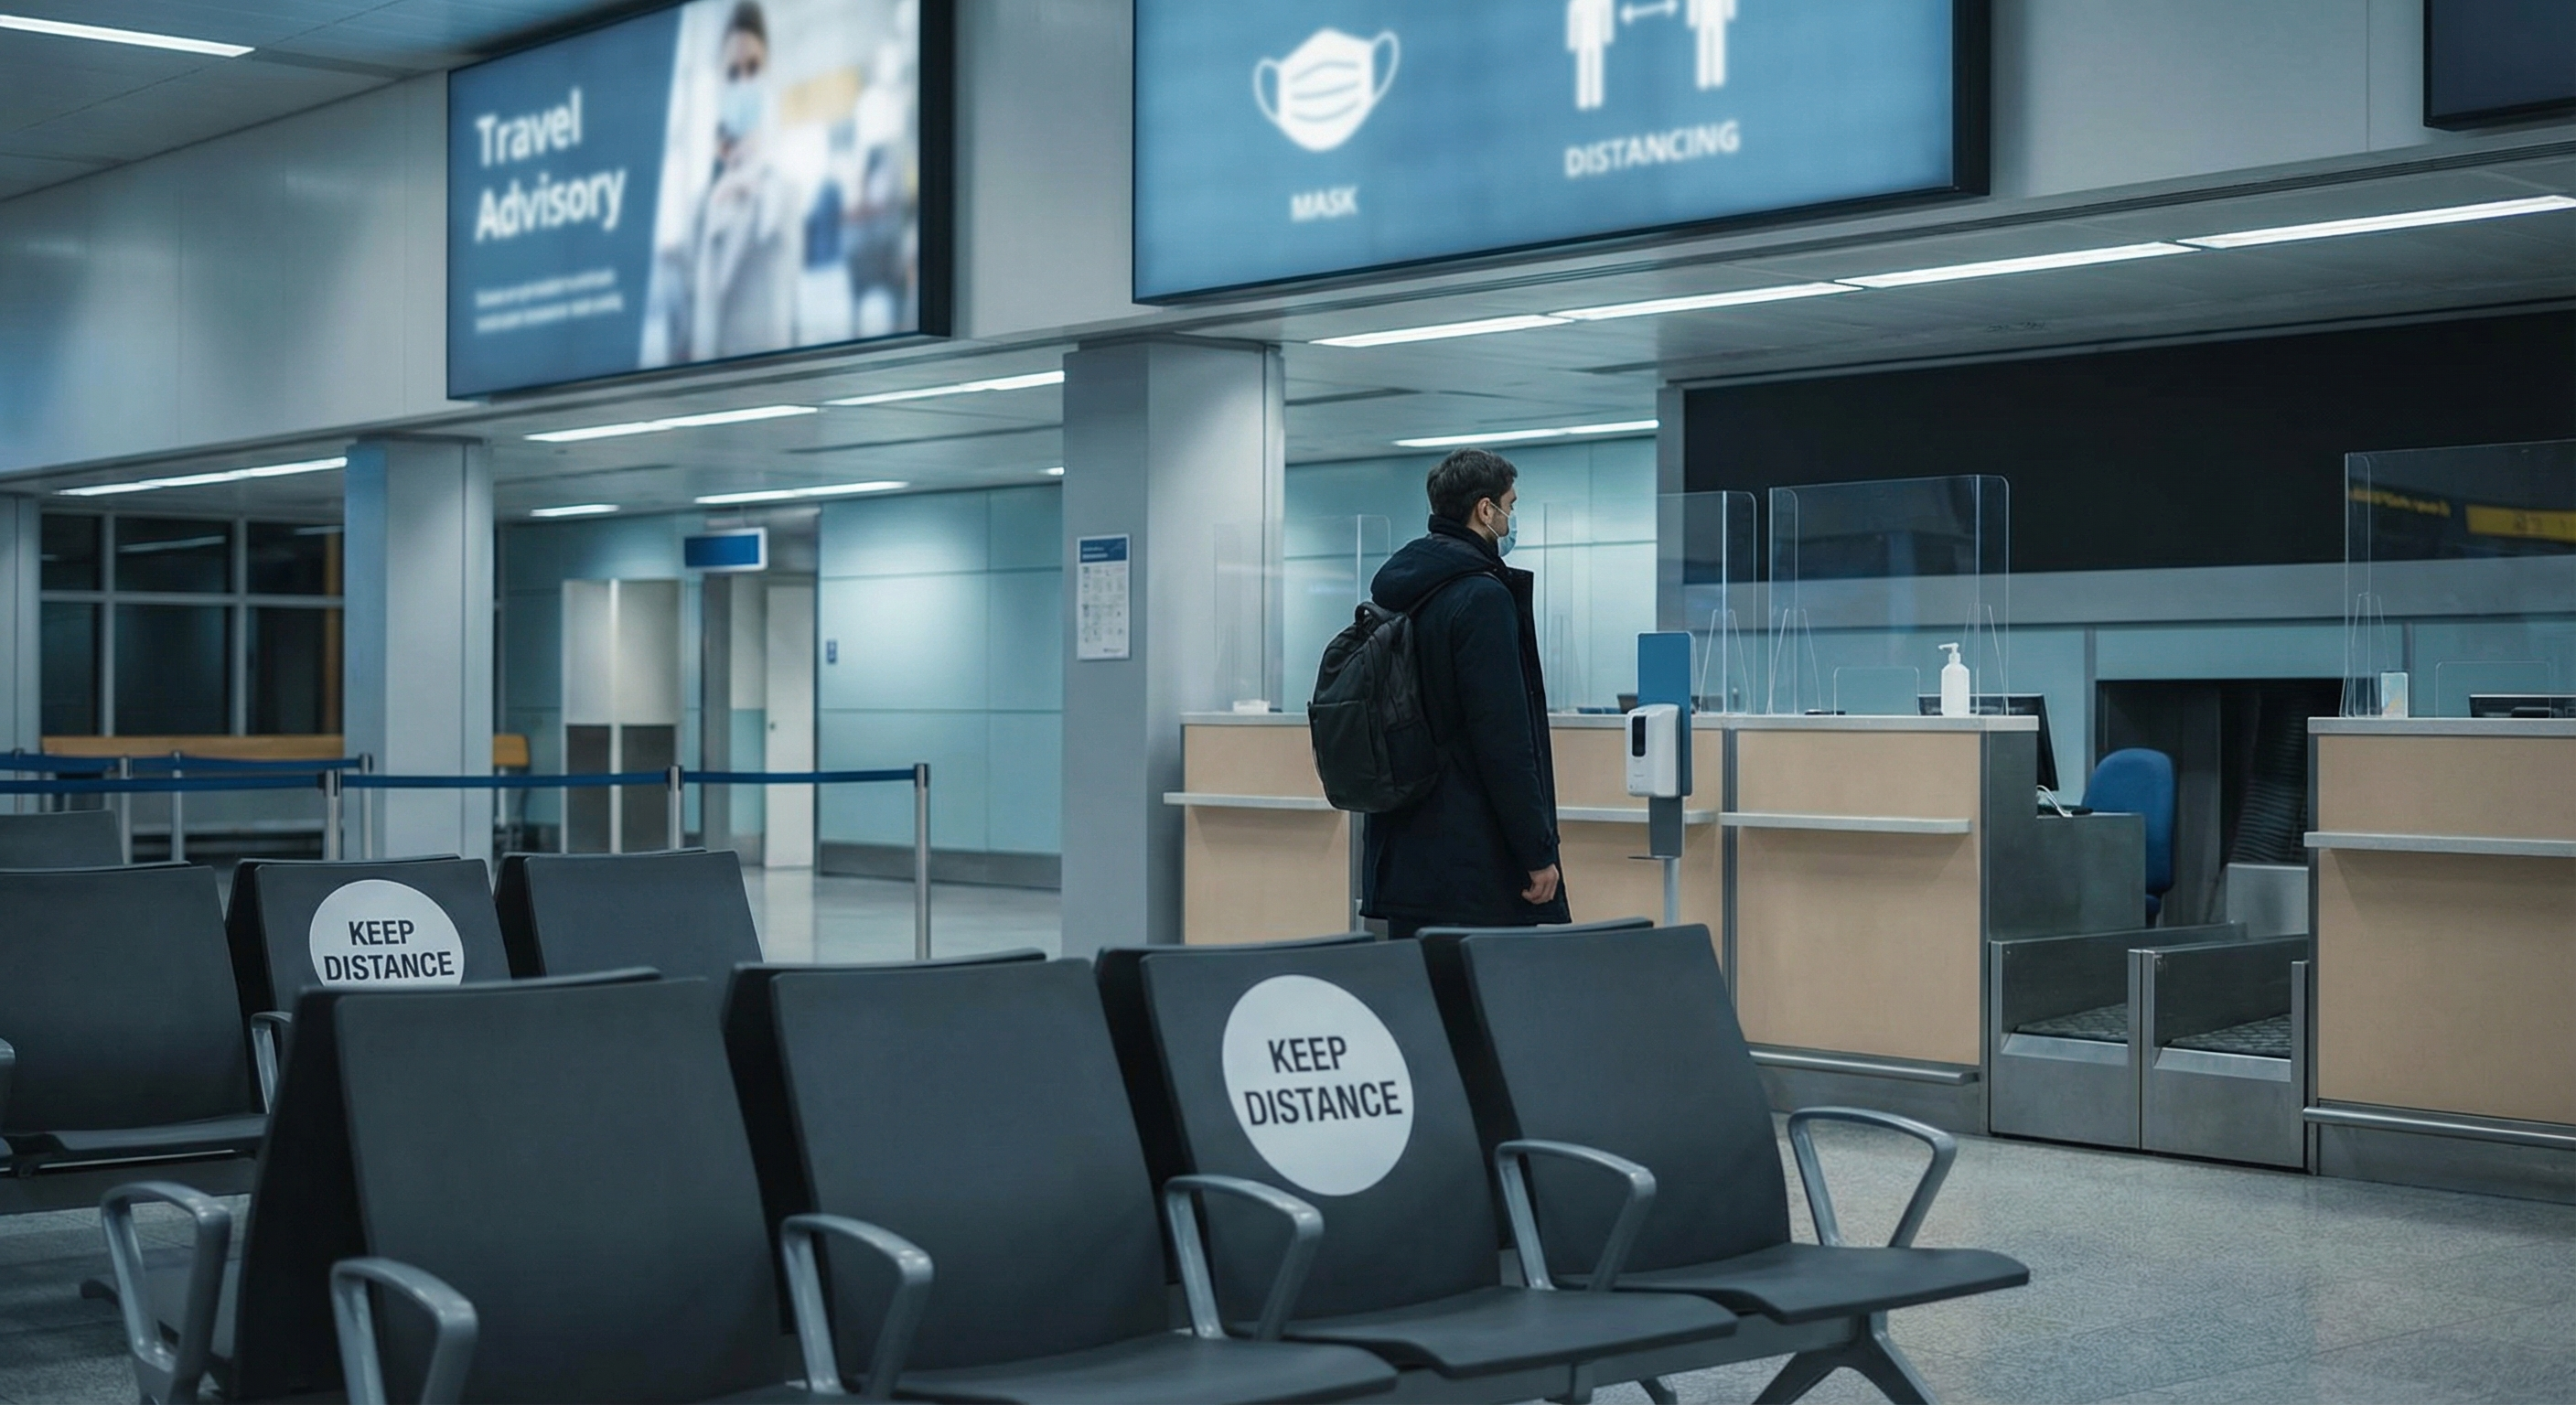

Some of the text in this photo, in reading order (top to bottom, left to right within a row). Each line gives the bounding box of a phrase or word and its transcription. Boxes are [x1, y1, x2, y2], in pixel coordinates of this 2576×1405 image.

[475, 87, 583, 167] Travel
[1564, 120, 1740, 178] DISTANCING
[475, 168, 627, 242] Advisory
[1291, 187, 1358, 220] MASK
[349, 919, 414, 946] KEEP
[324, 951, 455, 981] DISTANCE
[1268, 1035, 1347, 1073] KEEP
[1244, 1080, 1402, 1125] DISTANCE
